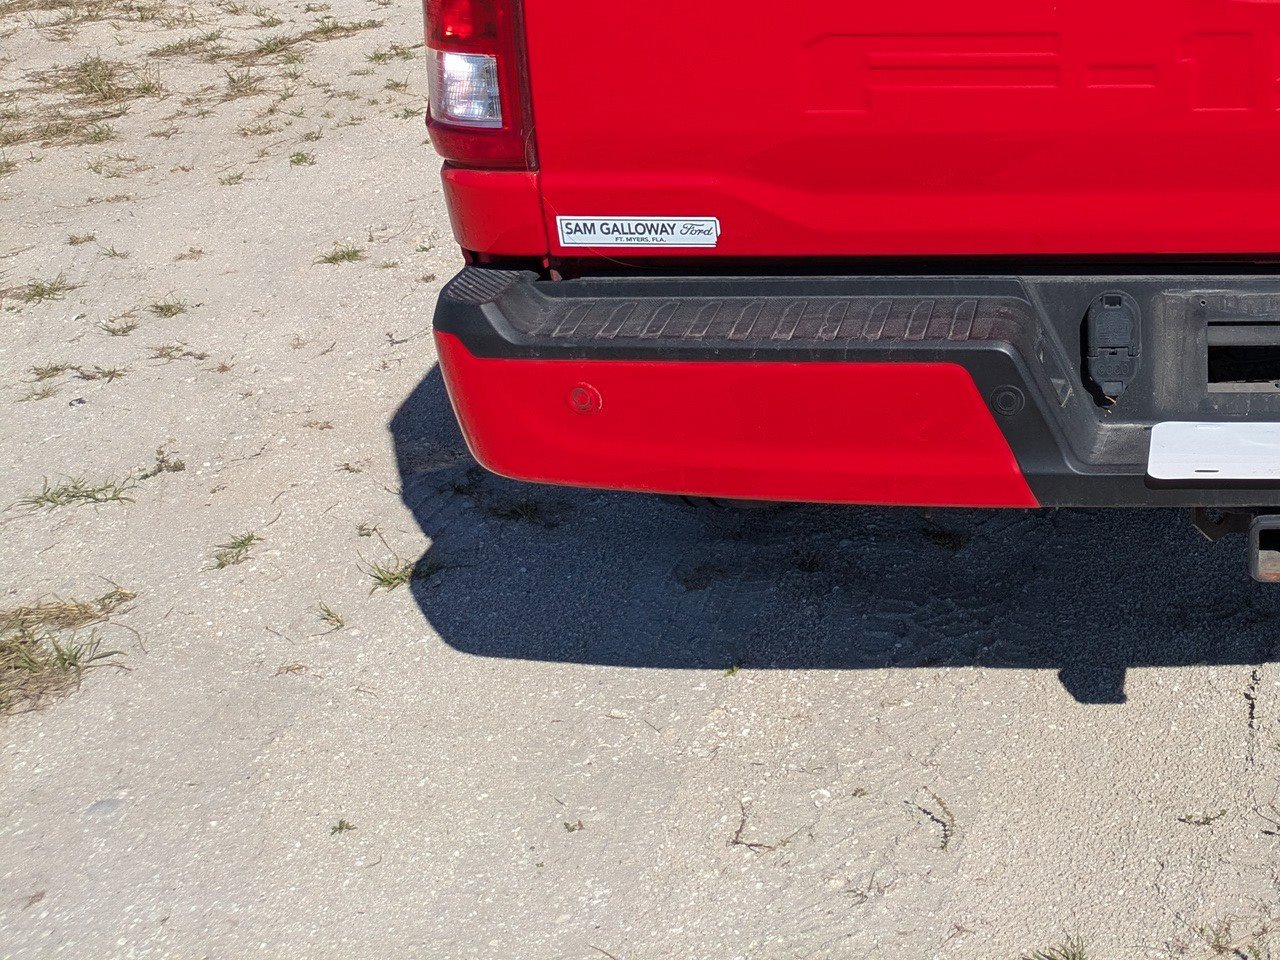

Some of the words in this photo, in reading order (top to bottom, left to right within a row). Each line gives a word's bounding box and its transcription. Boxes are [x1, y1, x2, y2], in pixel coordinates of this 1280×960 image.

[565, 222, 596, 235] SAM
[600, 222, 676, 236] GALLOWAY
[679, 223, 713, 236] Ford
